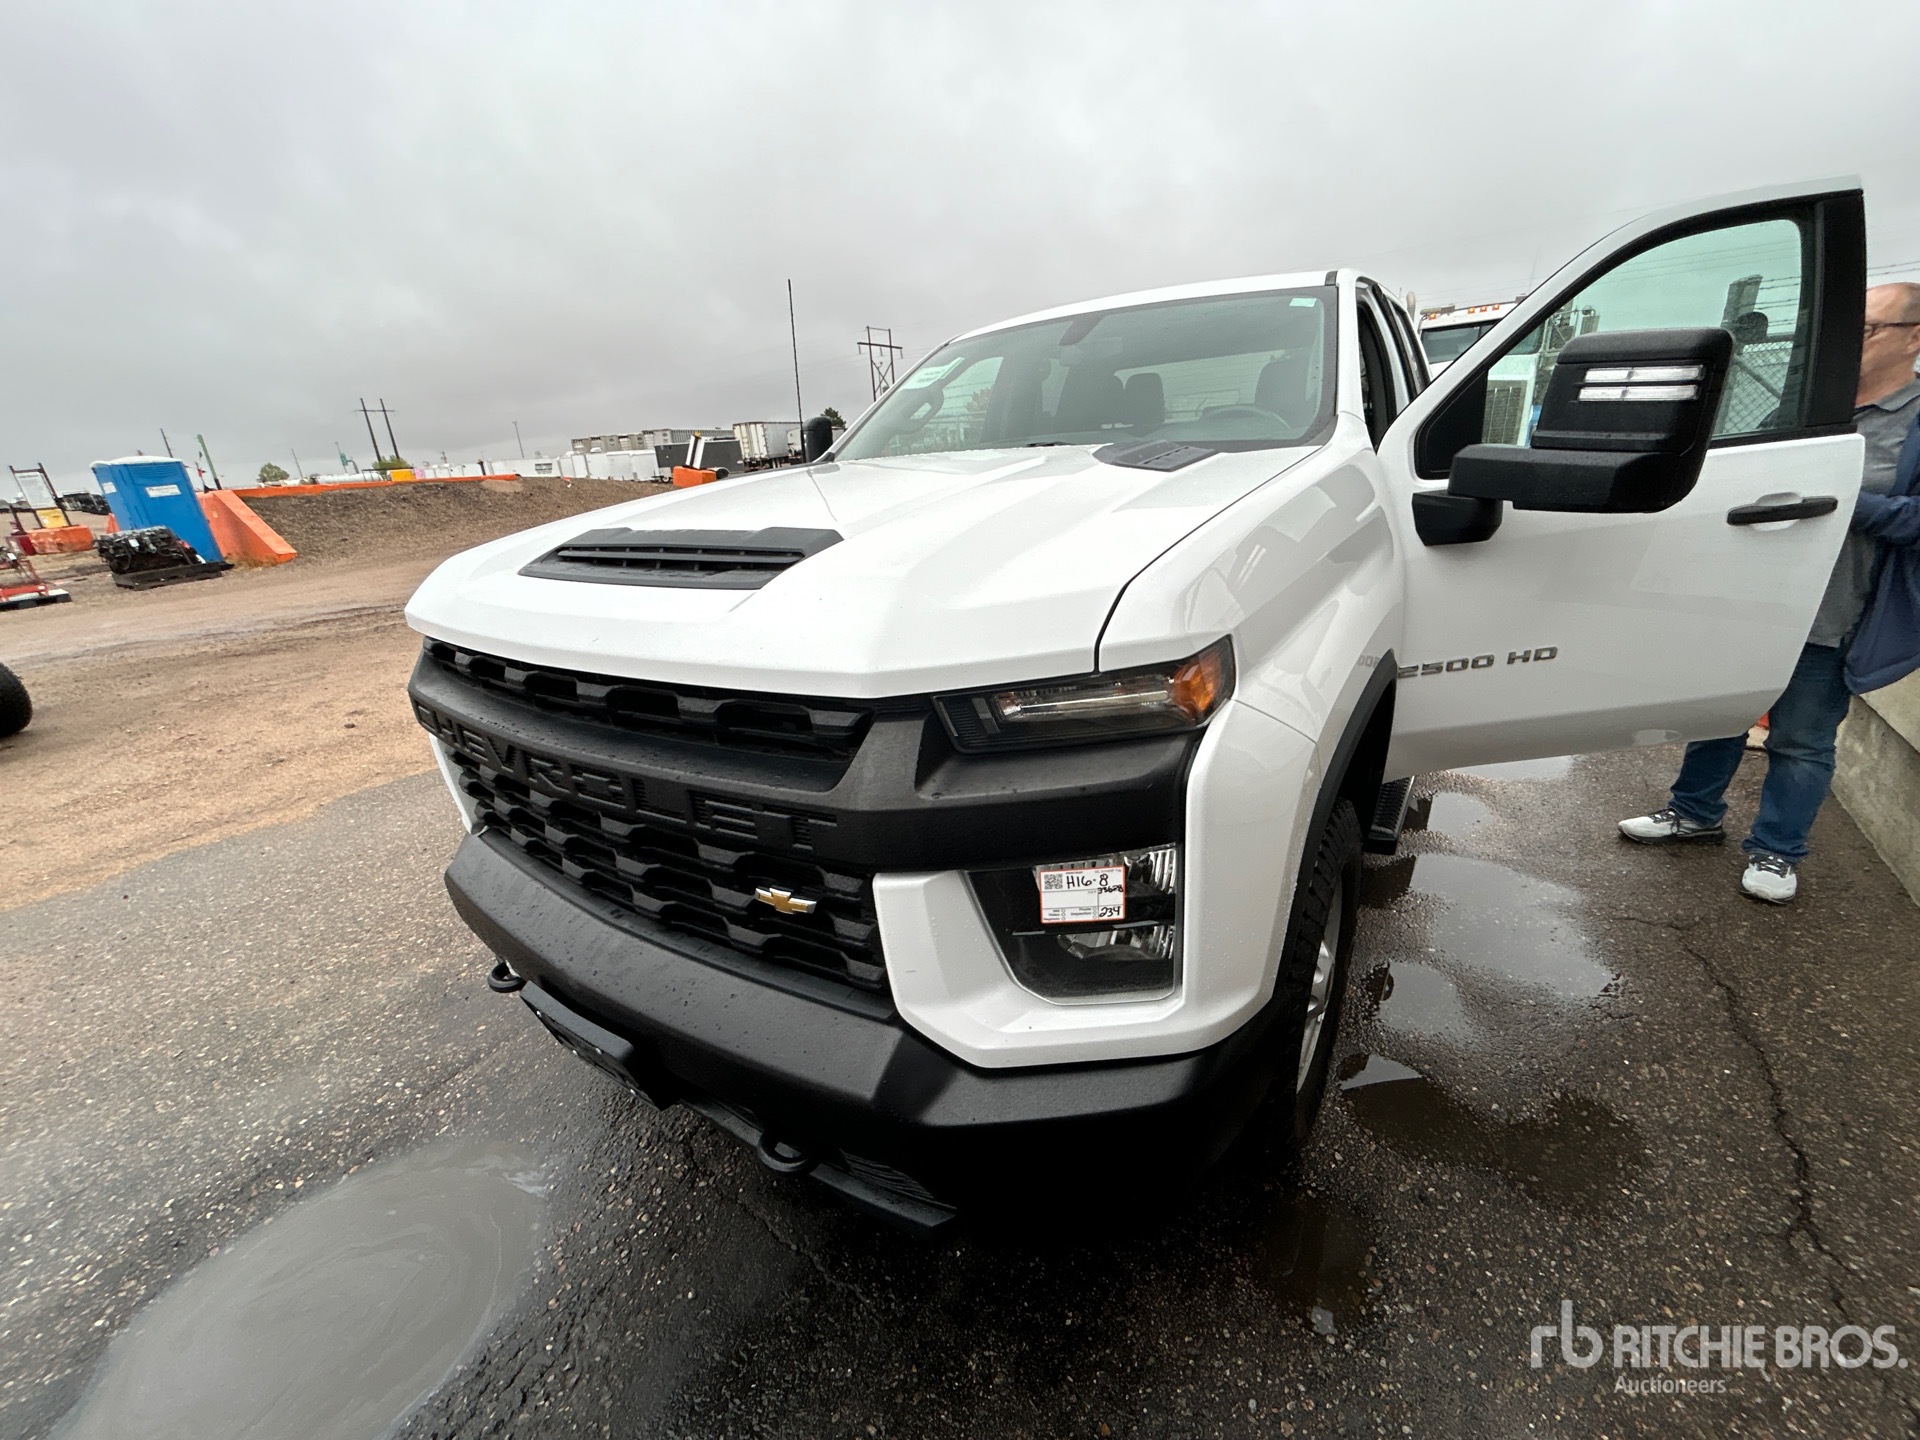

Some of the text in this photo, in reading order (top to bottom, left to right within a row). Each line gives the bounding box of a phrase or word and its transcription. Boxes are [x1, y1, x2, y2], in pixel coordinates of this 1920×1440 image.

[1397, 654, 1495, 679] 2500
[1506, 646, 1558, 665] HD
[1099, 906, 1121, 918] 234
